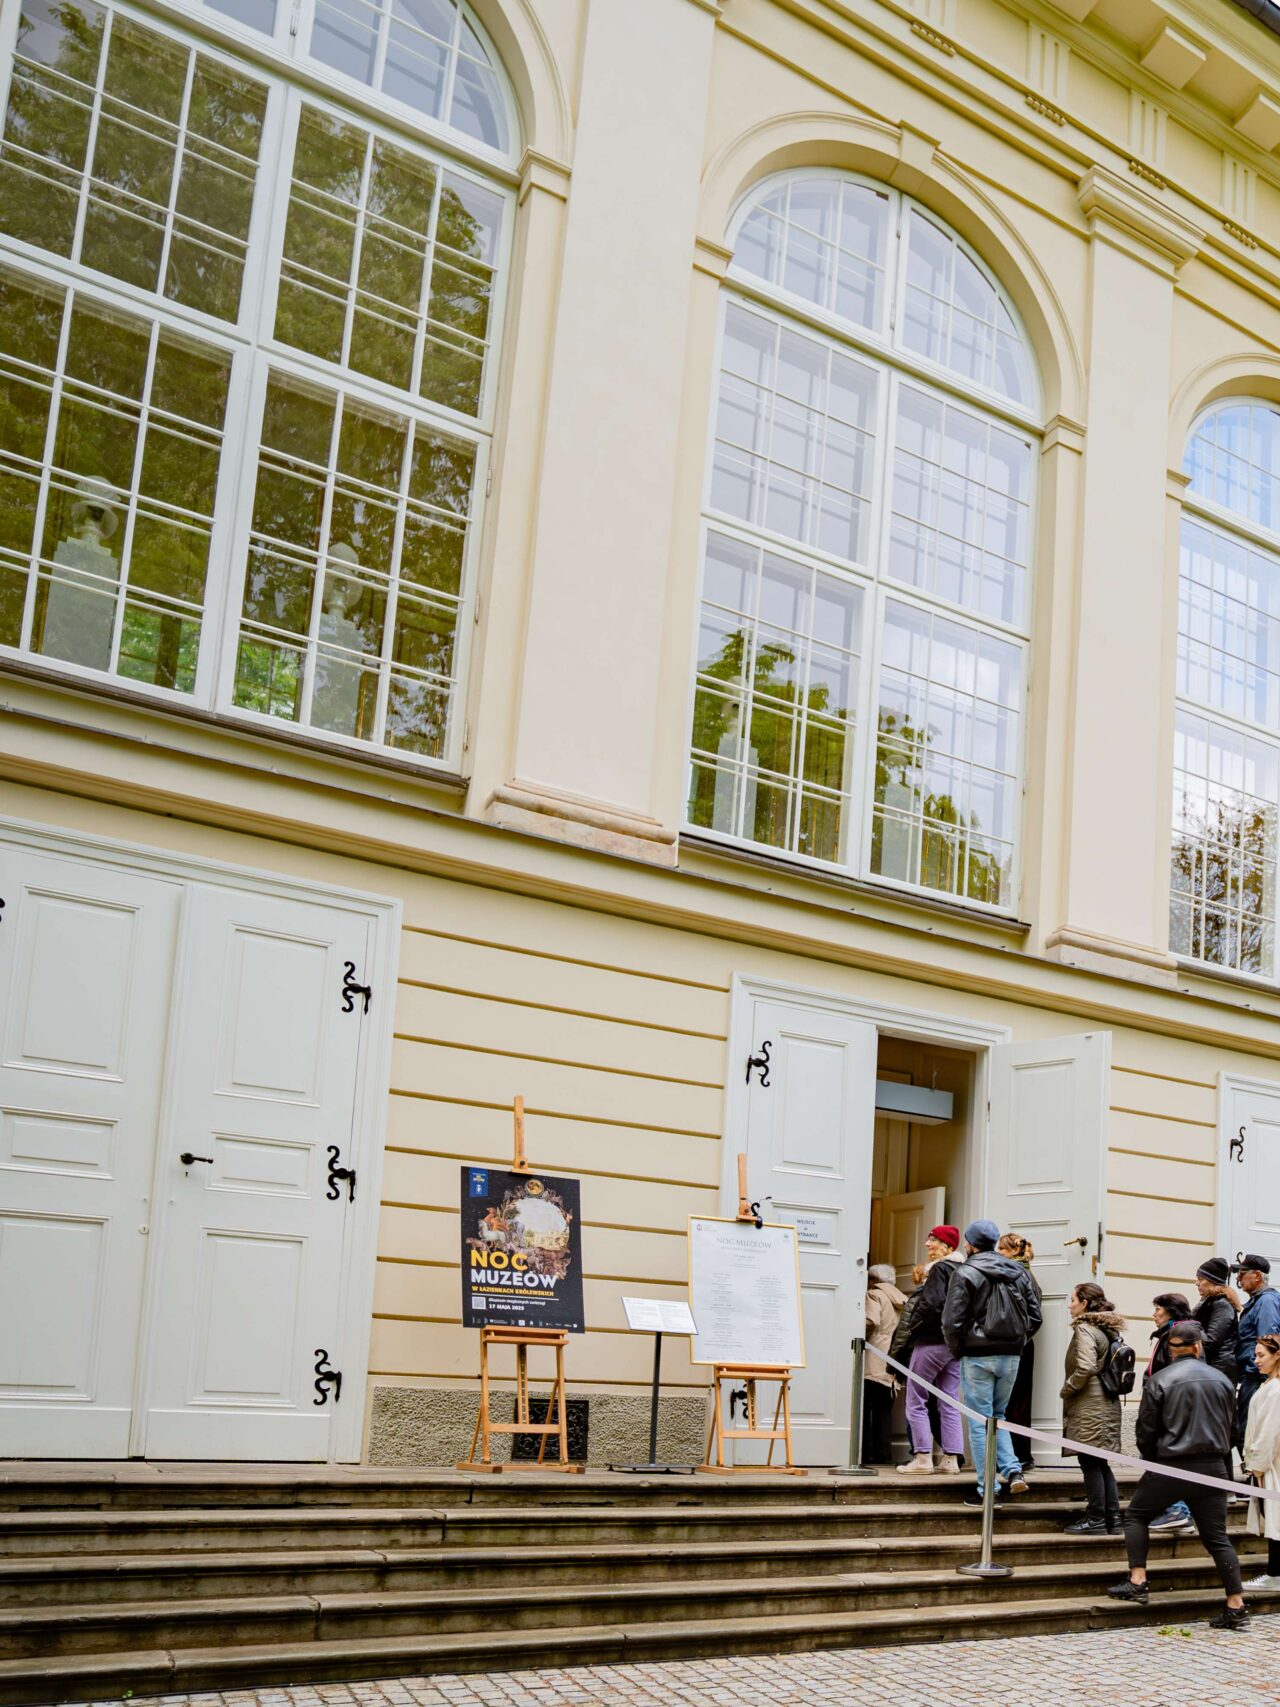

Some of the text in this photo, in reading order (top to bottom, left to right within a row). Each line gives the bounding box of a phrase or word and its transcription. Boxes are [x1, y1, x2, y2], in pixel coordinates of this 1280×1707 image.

[716, 1237, 735, 1246] NOC
[736, 1239, 772, 1249] MUZEÓW
[471, 1249, 528, 1271] NOC
[471, 1269, 558, 1288] MUZEÓW
[479, 1286, 515, 1294] ŁAZIENKACH
